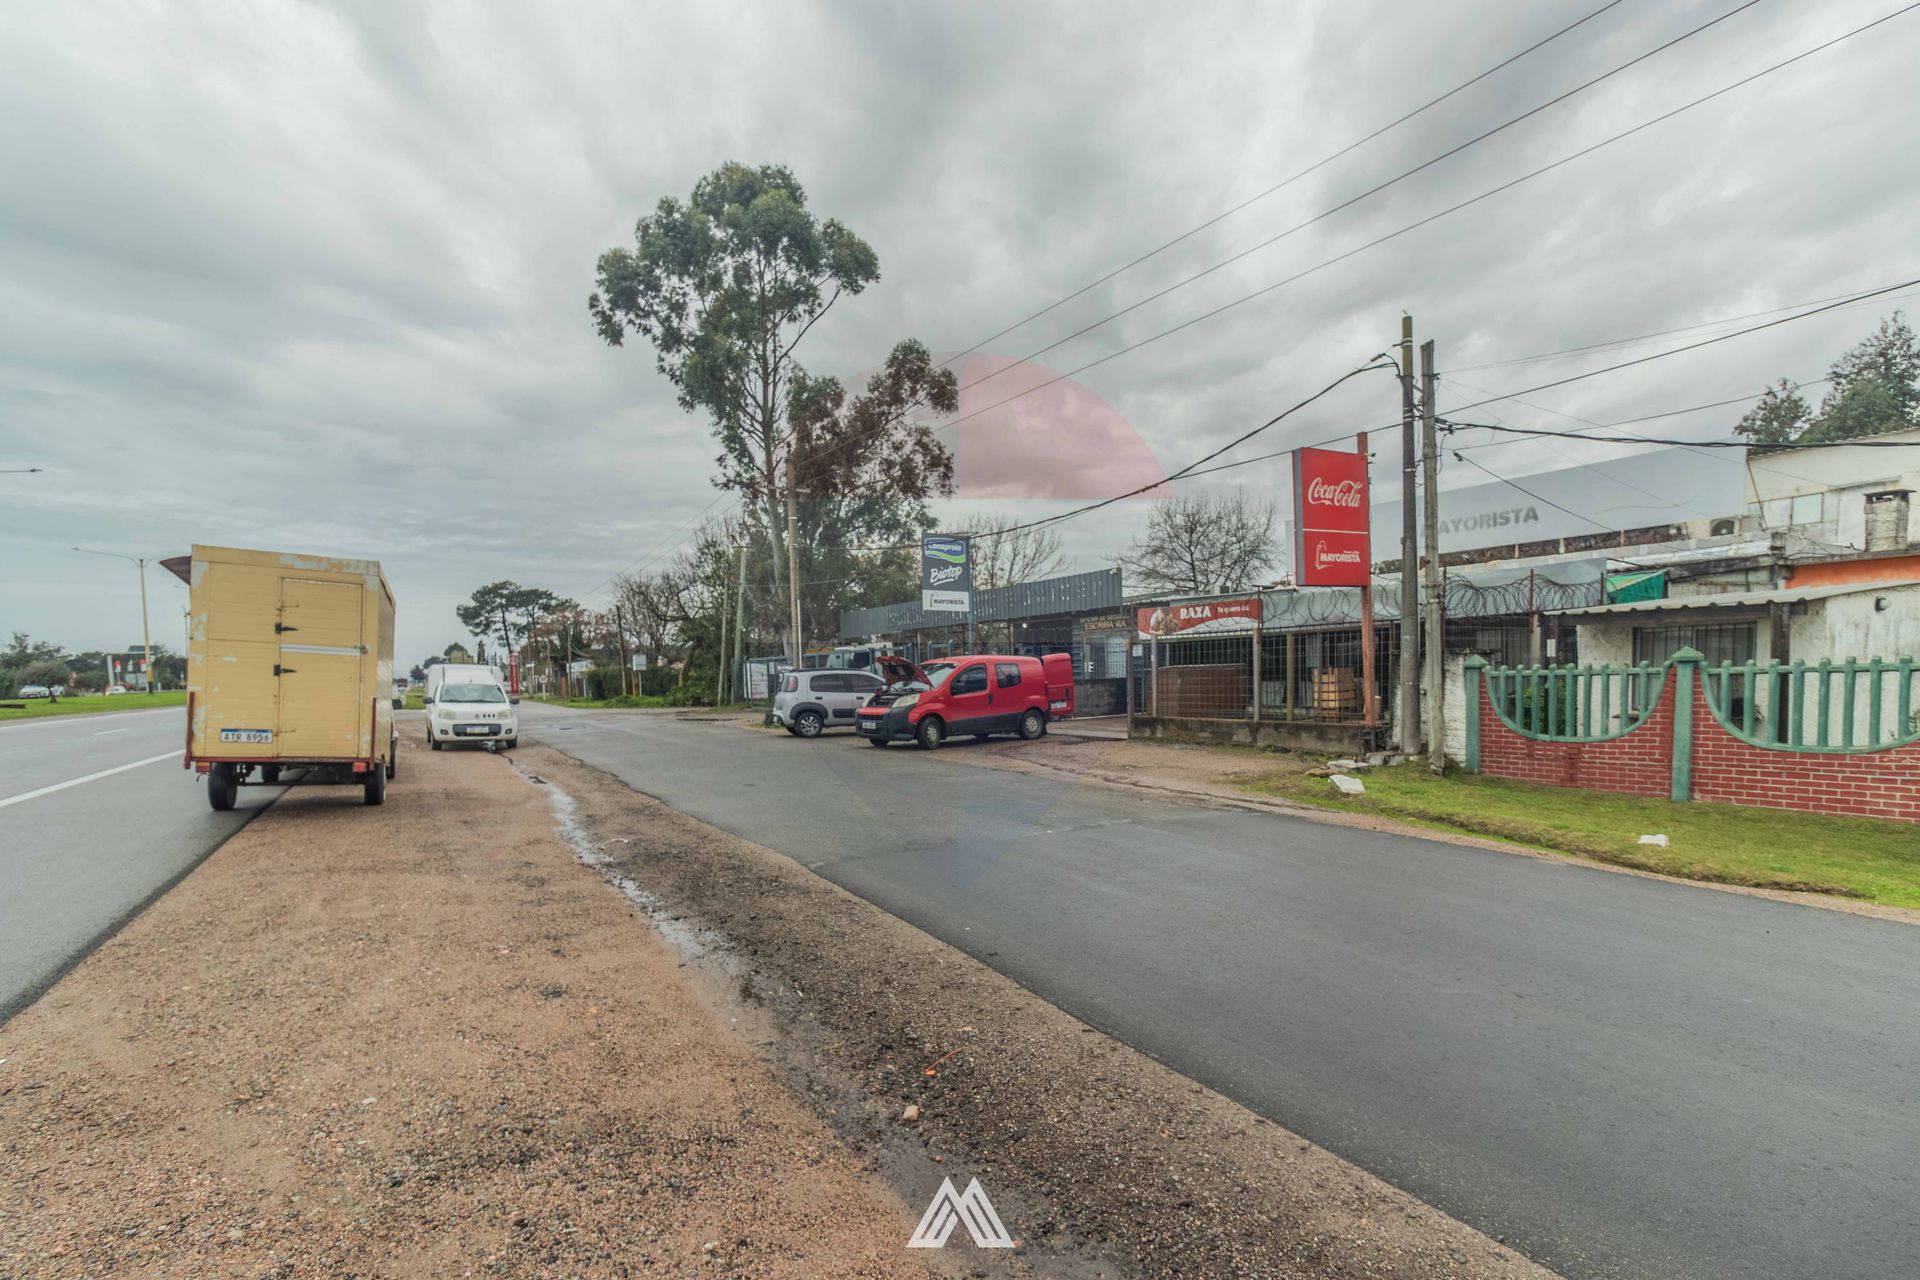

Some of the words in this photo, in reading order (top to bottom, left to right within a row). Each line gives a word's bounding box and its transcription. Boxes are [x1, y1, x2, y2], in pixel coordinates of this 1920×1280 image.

[1420, 506, 1539, 537] AYORISTA
[1320, 553, 1360, 562] MAYORISTA
[930, 565, 963, 583] Biotop
[1180, 606, 1212, 619] RAZA
